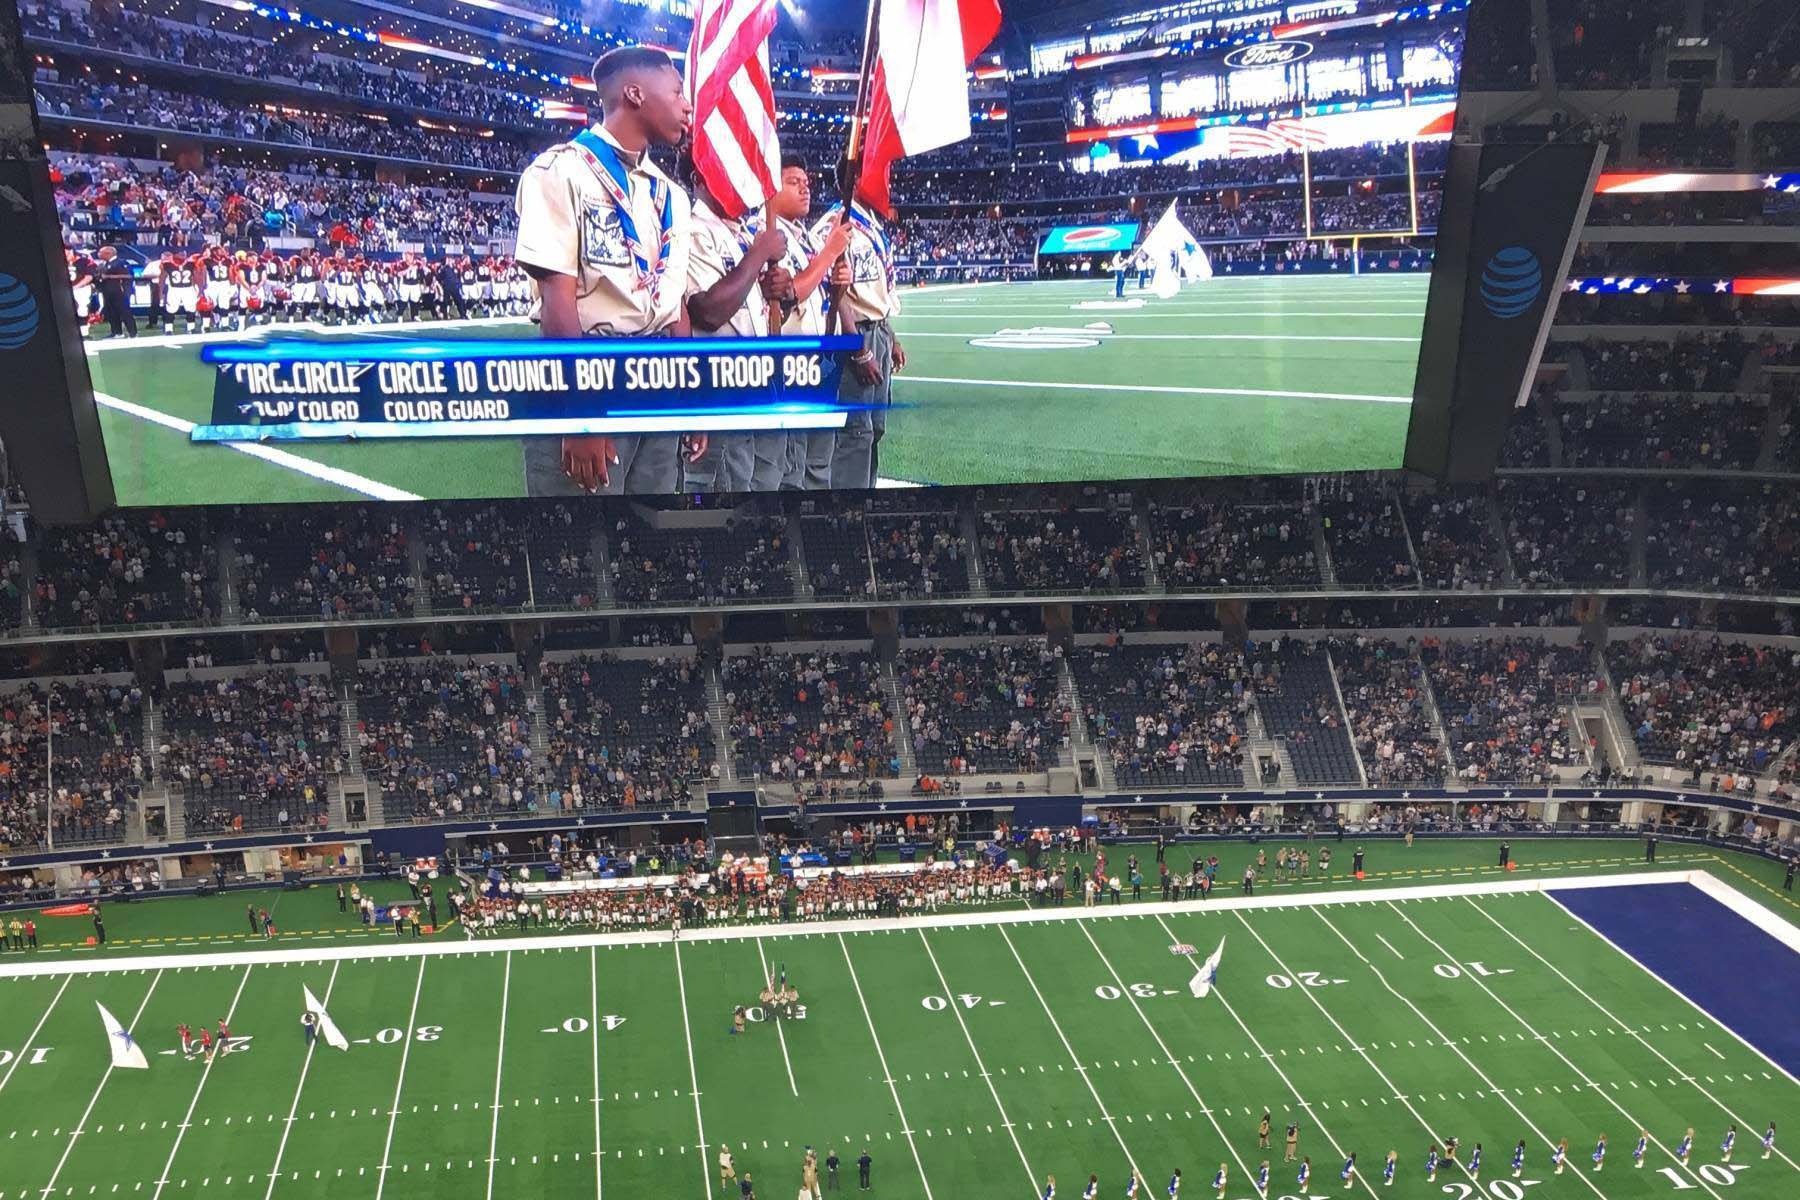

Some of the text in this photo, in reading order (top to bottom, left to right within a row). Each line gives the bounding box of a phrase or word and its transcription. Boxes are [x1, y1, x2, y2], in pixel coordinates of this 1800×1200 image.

[1241, 44, 1295, 65] Ford
[171, 269, 192, 284] 32
[378, 358, 447, 394] CIRCLE
[454, 359, 478, 393] 10
[486, 357, 569, 393] COUNCIL
[575, 357, 616, 391] BOY
[624, 356, 700, 390] SCOUTS
[708, 355, 774, 388] TROOP
[783, 354, 821, 387] 986
[384, 400, 443, 422] COLOR
[448, 399, 509, 421] GUARD
[1434, 962, 1494, 978] 10
[1266, 972, 1329, 988] 20
[1095, 984, 1156, 999] 30
[922, 994, 982, 1010] 40
[563, 1015, 626, 1032] 40
[376, 1026, 443, 1043] 30
[1656, 1165, 1733, 1189] 10
